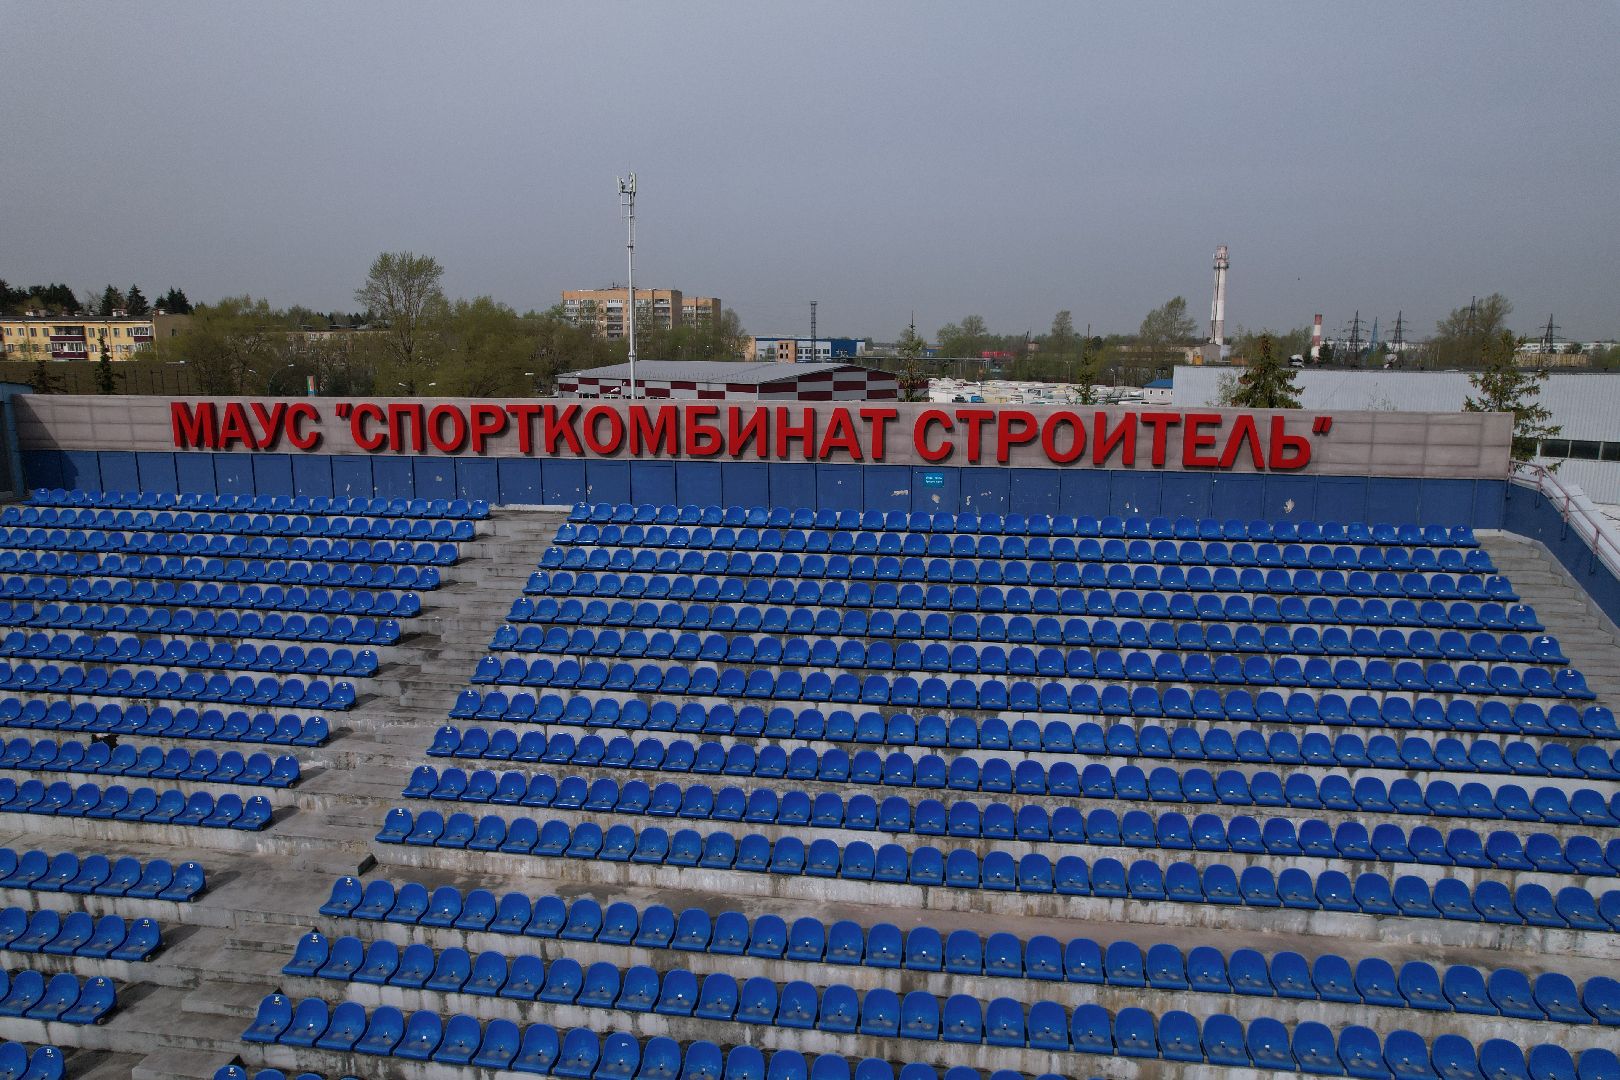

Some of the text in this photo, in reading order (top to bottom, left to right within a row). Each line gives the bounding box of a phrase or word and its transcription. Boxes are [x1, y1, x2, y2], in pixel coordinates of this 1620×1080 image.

[171, 401, 1333, 469] МАУС "СПОРТКОМБИНАТ СТРОИТЕЛЬ"
